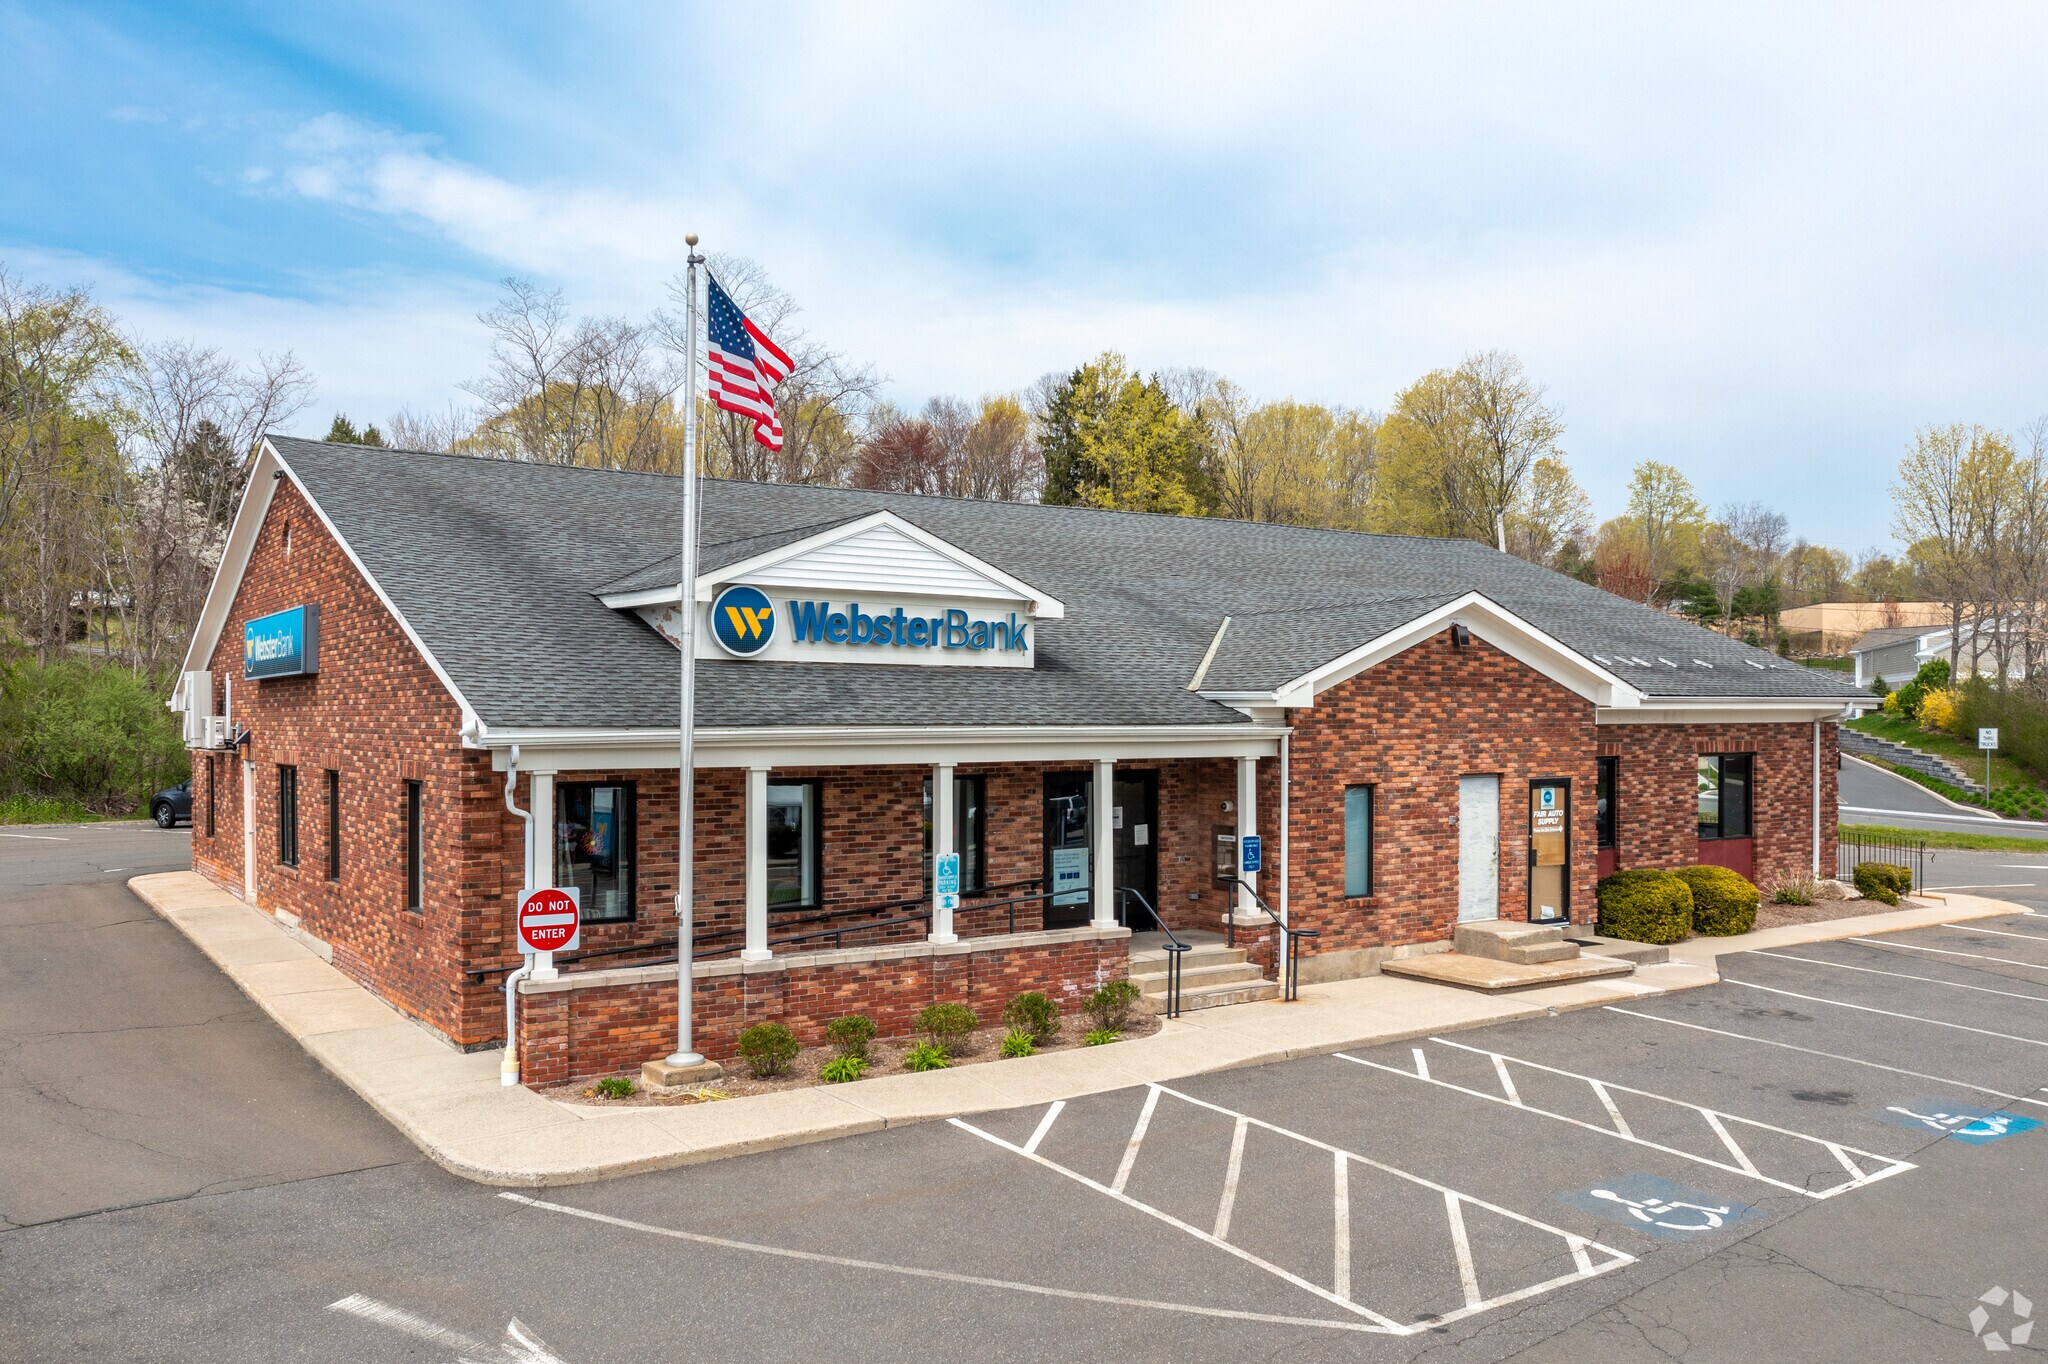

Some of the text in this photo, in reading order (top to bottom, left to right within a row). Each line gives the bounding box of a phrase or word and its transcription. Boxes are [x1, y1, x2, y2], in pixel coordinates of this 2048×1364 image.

[785, 600, 1029, 652] WebsterBank
[255, 628, 294, 662] WebsterBank
[1533, 809, 1563, 818] FAIR AUTO
[1537, 817, 1559, 825] SUPPLY
[528, 900, 570, 912] DO NOT
[532, 928, 565, 940] ENTER
